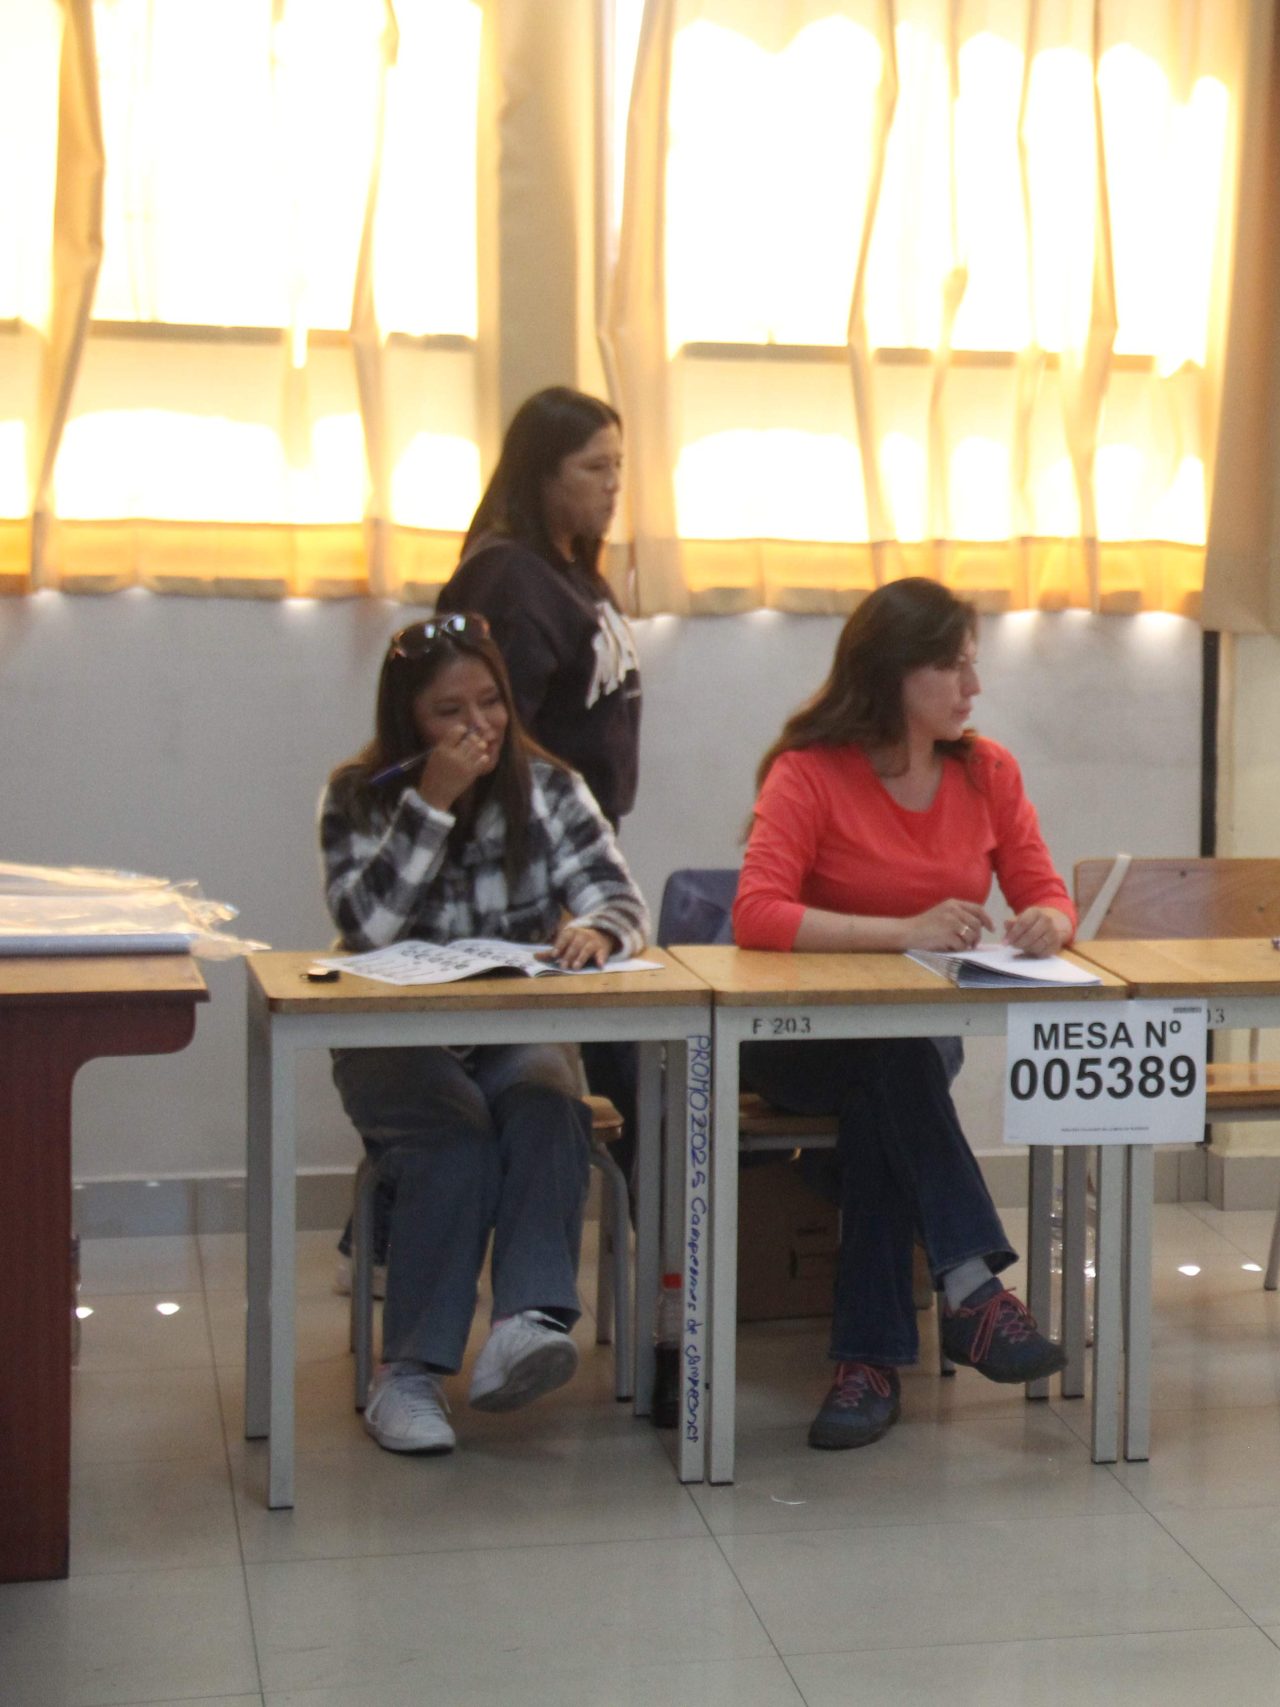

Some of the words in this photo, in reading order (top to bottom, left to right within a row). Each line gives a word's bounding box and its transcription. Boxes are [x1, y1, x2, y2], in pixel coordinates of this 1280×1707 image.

[752, 1018, 762, 1034] F
[773, 1017, 811, 1034] 203
[1033, 1021, 1134, 1050] MESA
[1010, 1055, 1197, 1101] 005389
